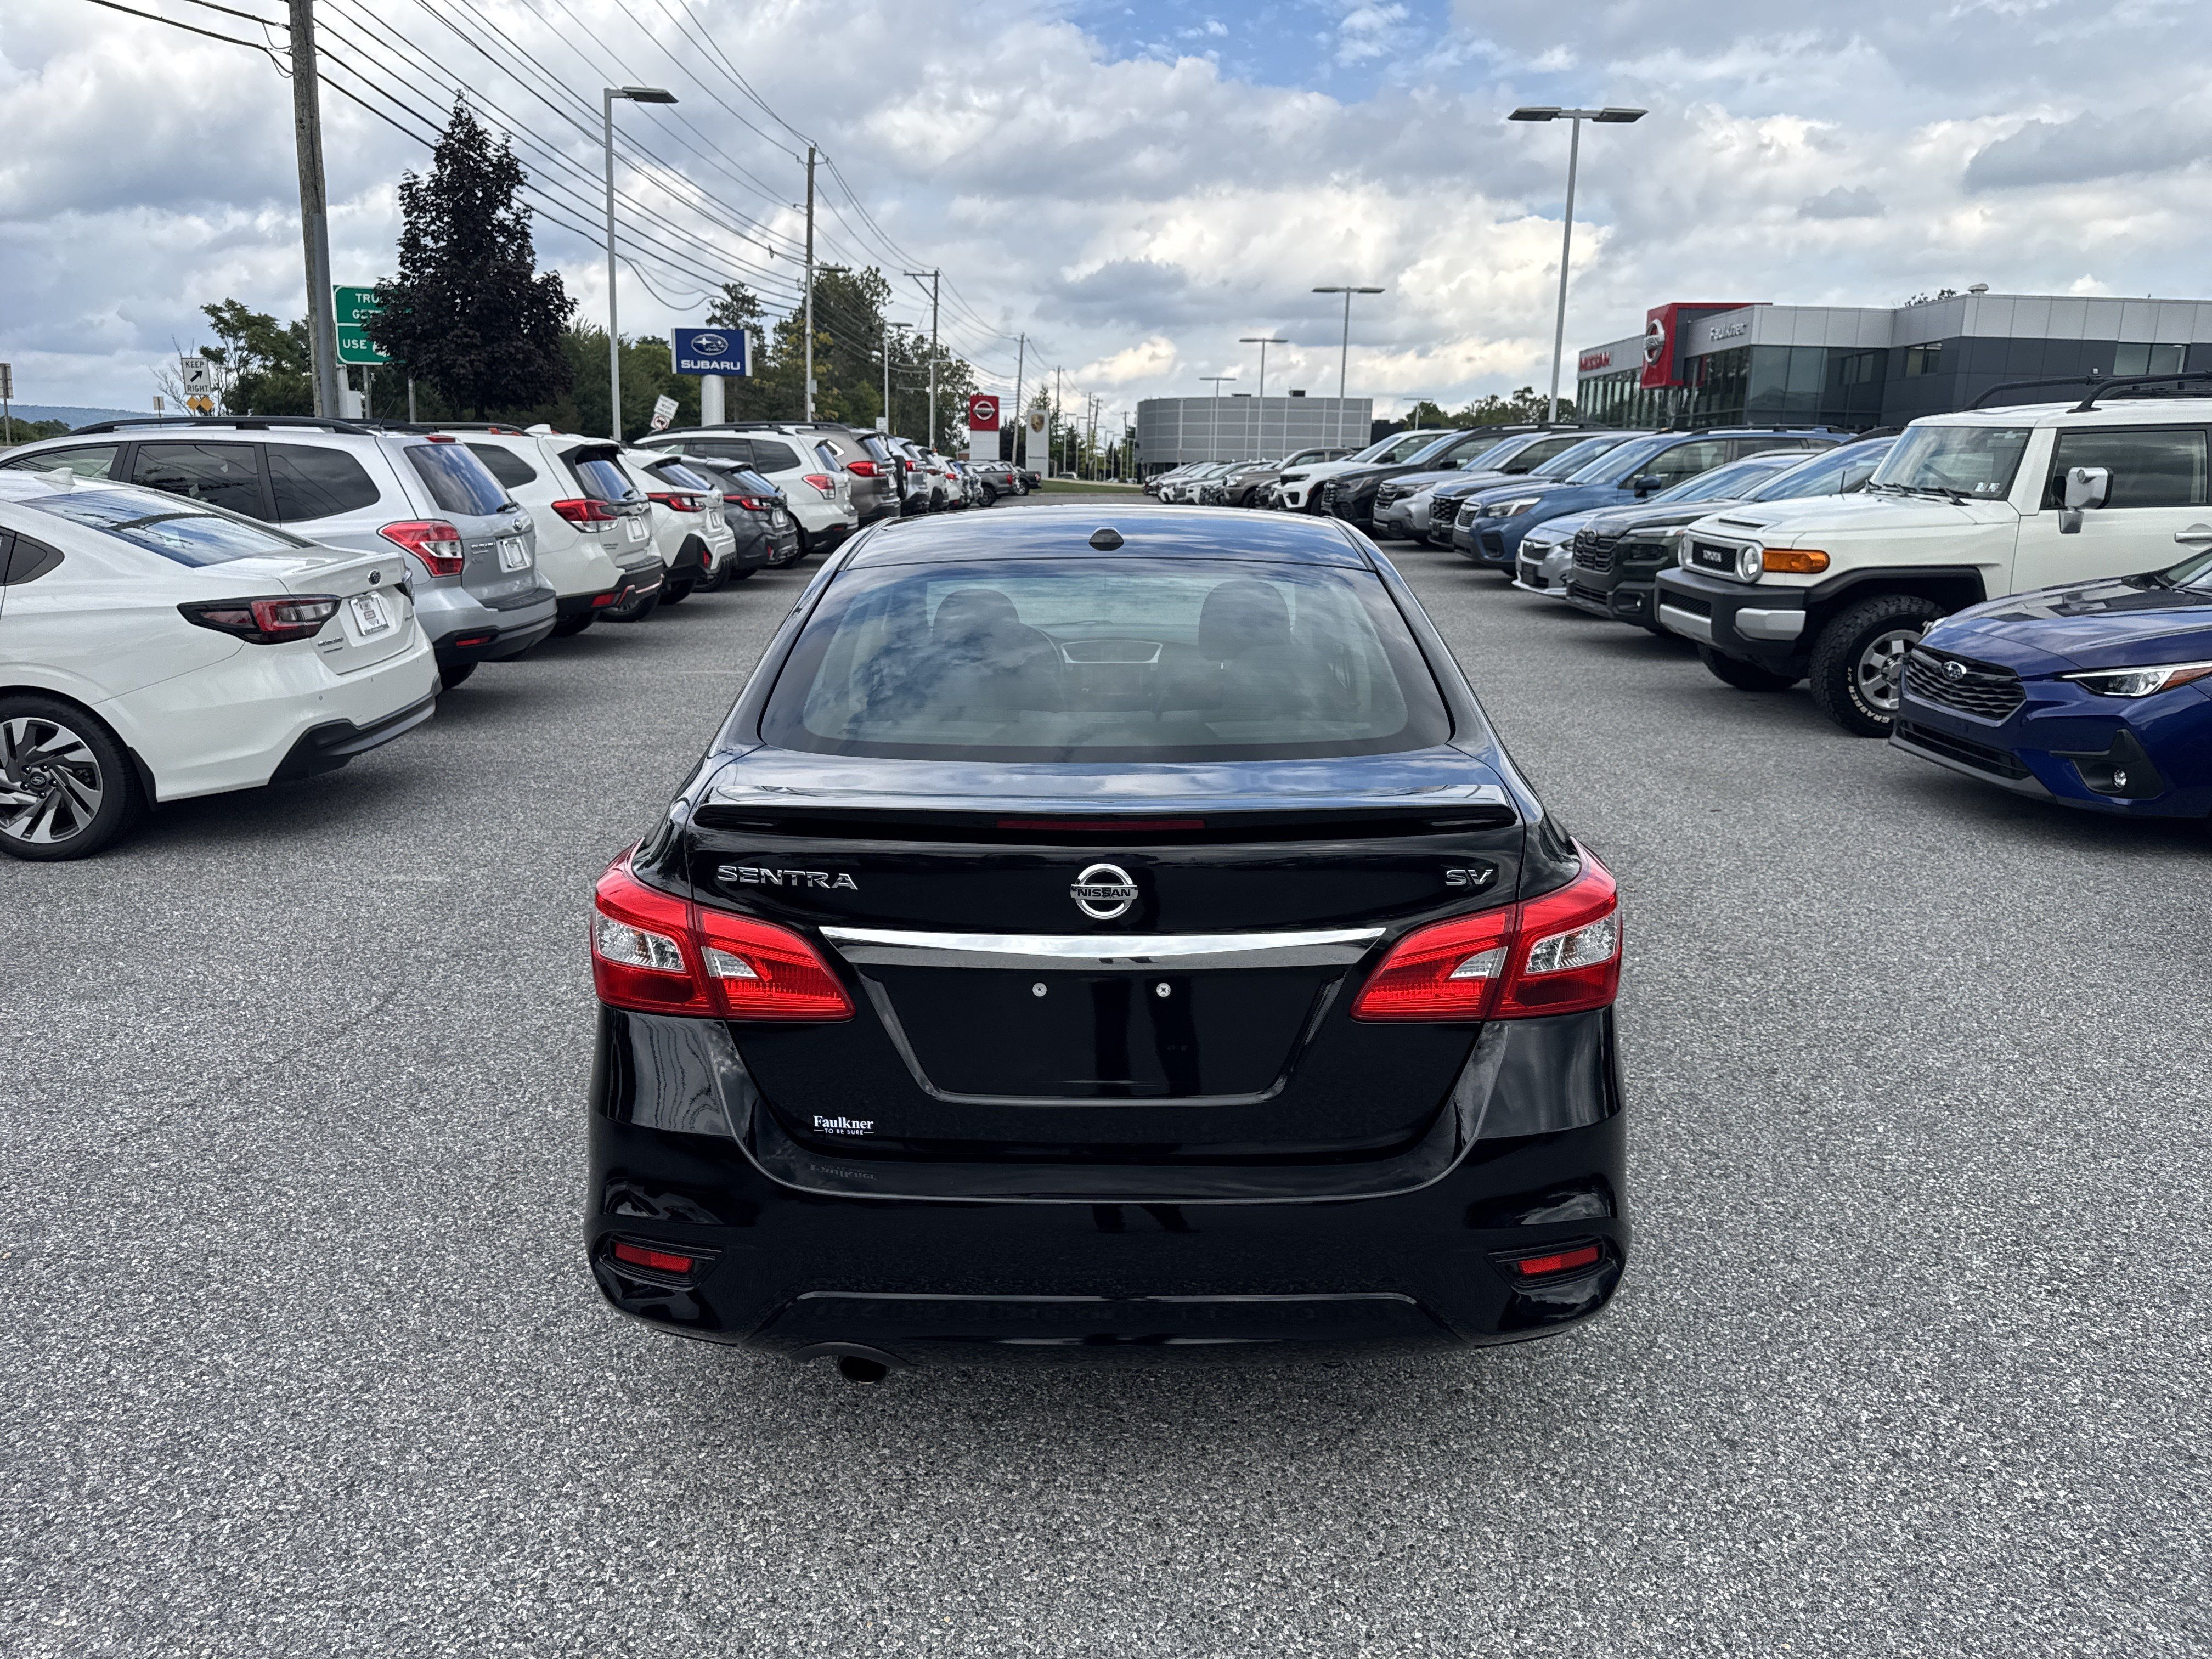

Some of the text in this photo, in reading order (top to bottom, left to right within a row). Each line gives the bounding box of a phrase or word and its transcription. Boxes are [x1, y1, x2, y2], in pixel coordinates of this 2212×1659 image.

[355, 292, 380, 303] TRU
[342, 338, 368, 349] USE
[185, 360, 204, 369] KEEP
[680, 359, 741, 371] SUBARU
[187, 384, 208, 393] RIGHT
[1848, 685, 1891, 724] GRABBER
[717, 865, 859, 890] SENTRA
[1444, 868, 1493, 885] SV
[1077, 887, 1131, 898] NISSAN
[812, 1115, 874, 1130] Faulkner
